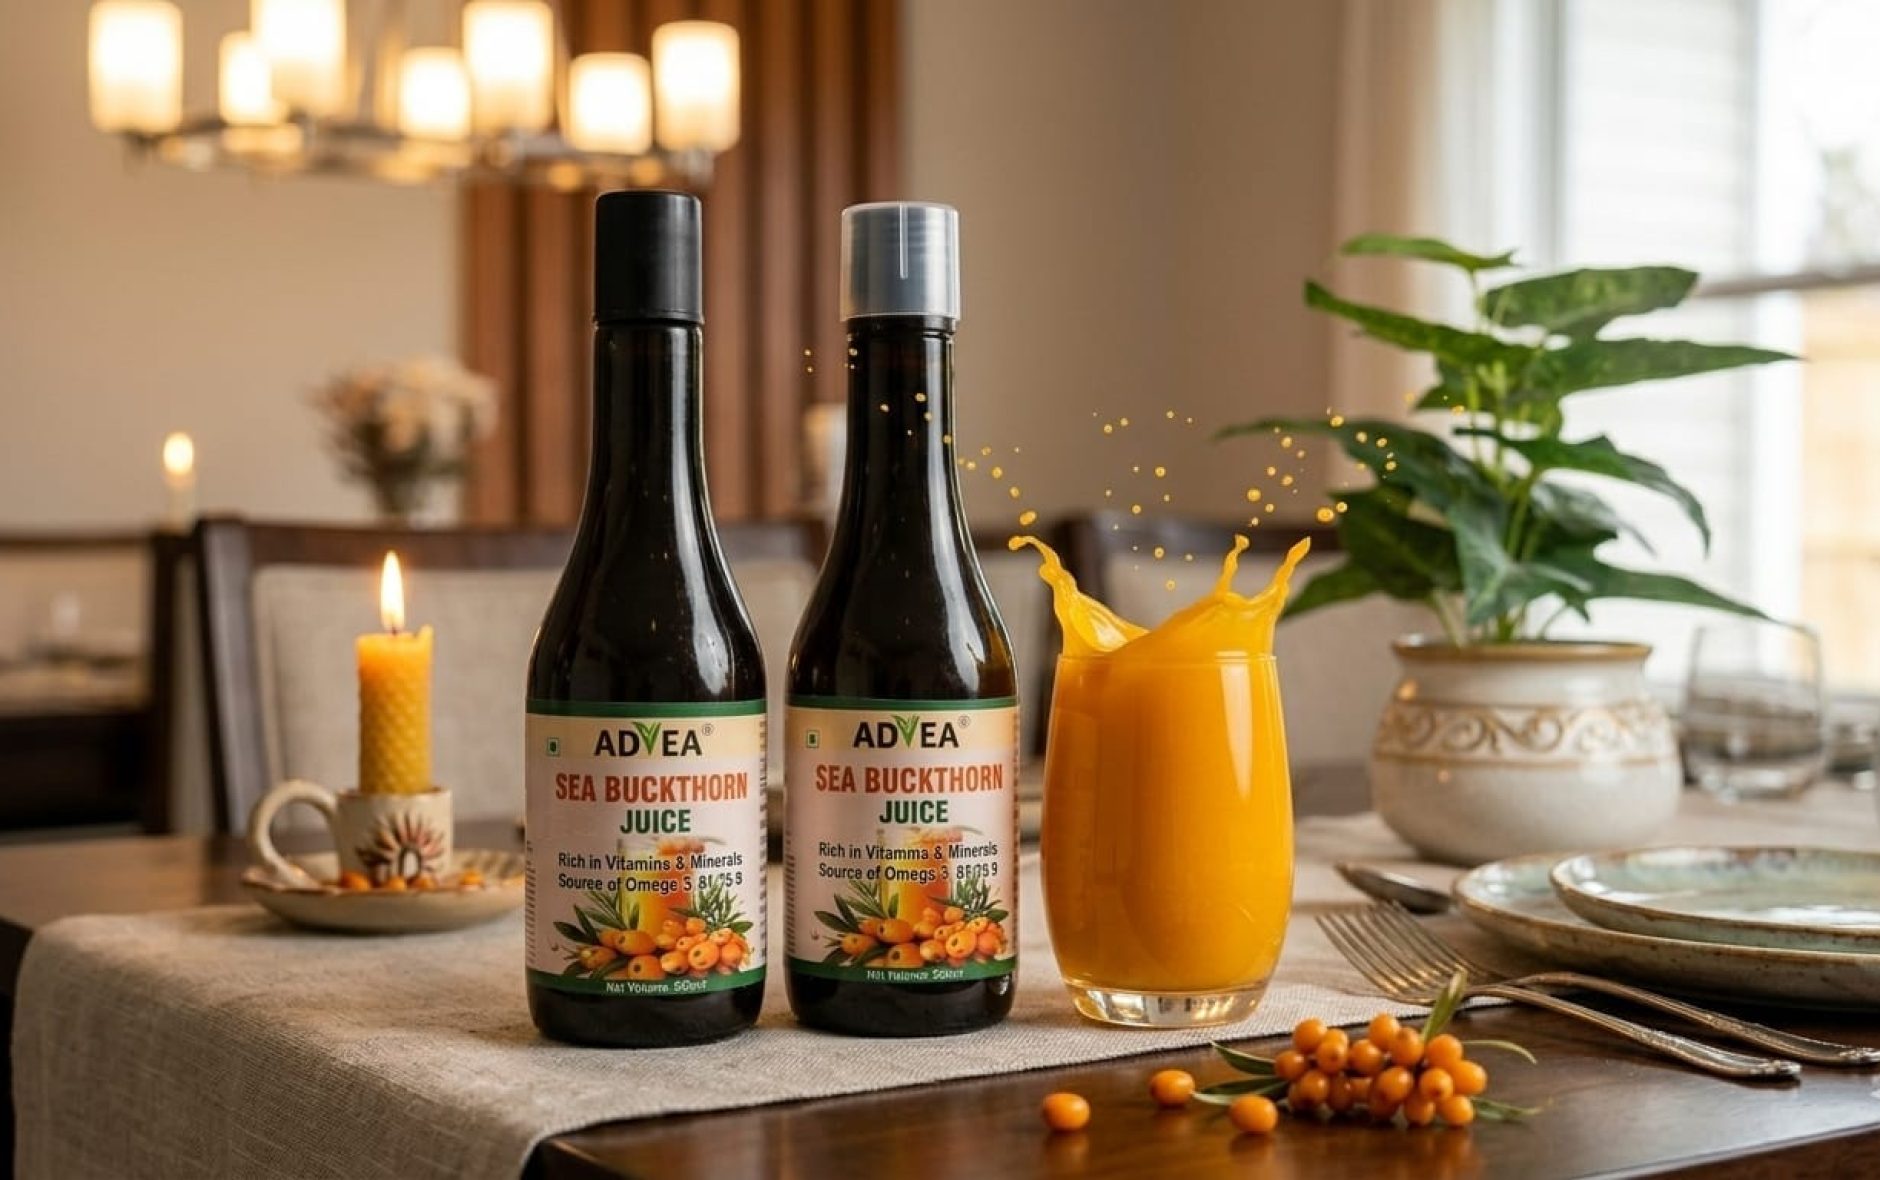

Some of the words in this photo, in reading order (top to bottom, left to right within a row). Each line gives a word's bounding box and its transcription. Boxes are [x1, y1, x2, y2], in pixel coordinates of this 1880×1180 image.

[555, 772, 597, 802] SEA
[605, 772, 748, 803] BUCKTHORN
[816, 763, 856, 794] SEA
[865, 763, 1003, 794] BUCKTHORN
[620, 809, 691, 834] JUICE
[879, 800, 949, 824] JUICE
[559, 852, 586, 869] Rich
[589, 854, 601, 870] in
[605, 855, 671, 871] Vitamins
[691, 851, 743, 869] Minerals
[849, 844, 861, 859] in
[934, 845, 943, 860] &
